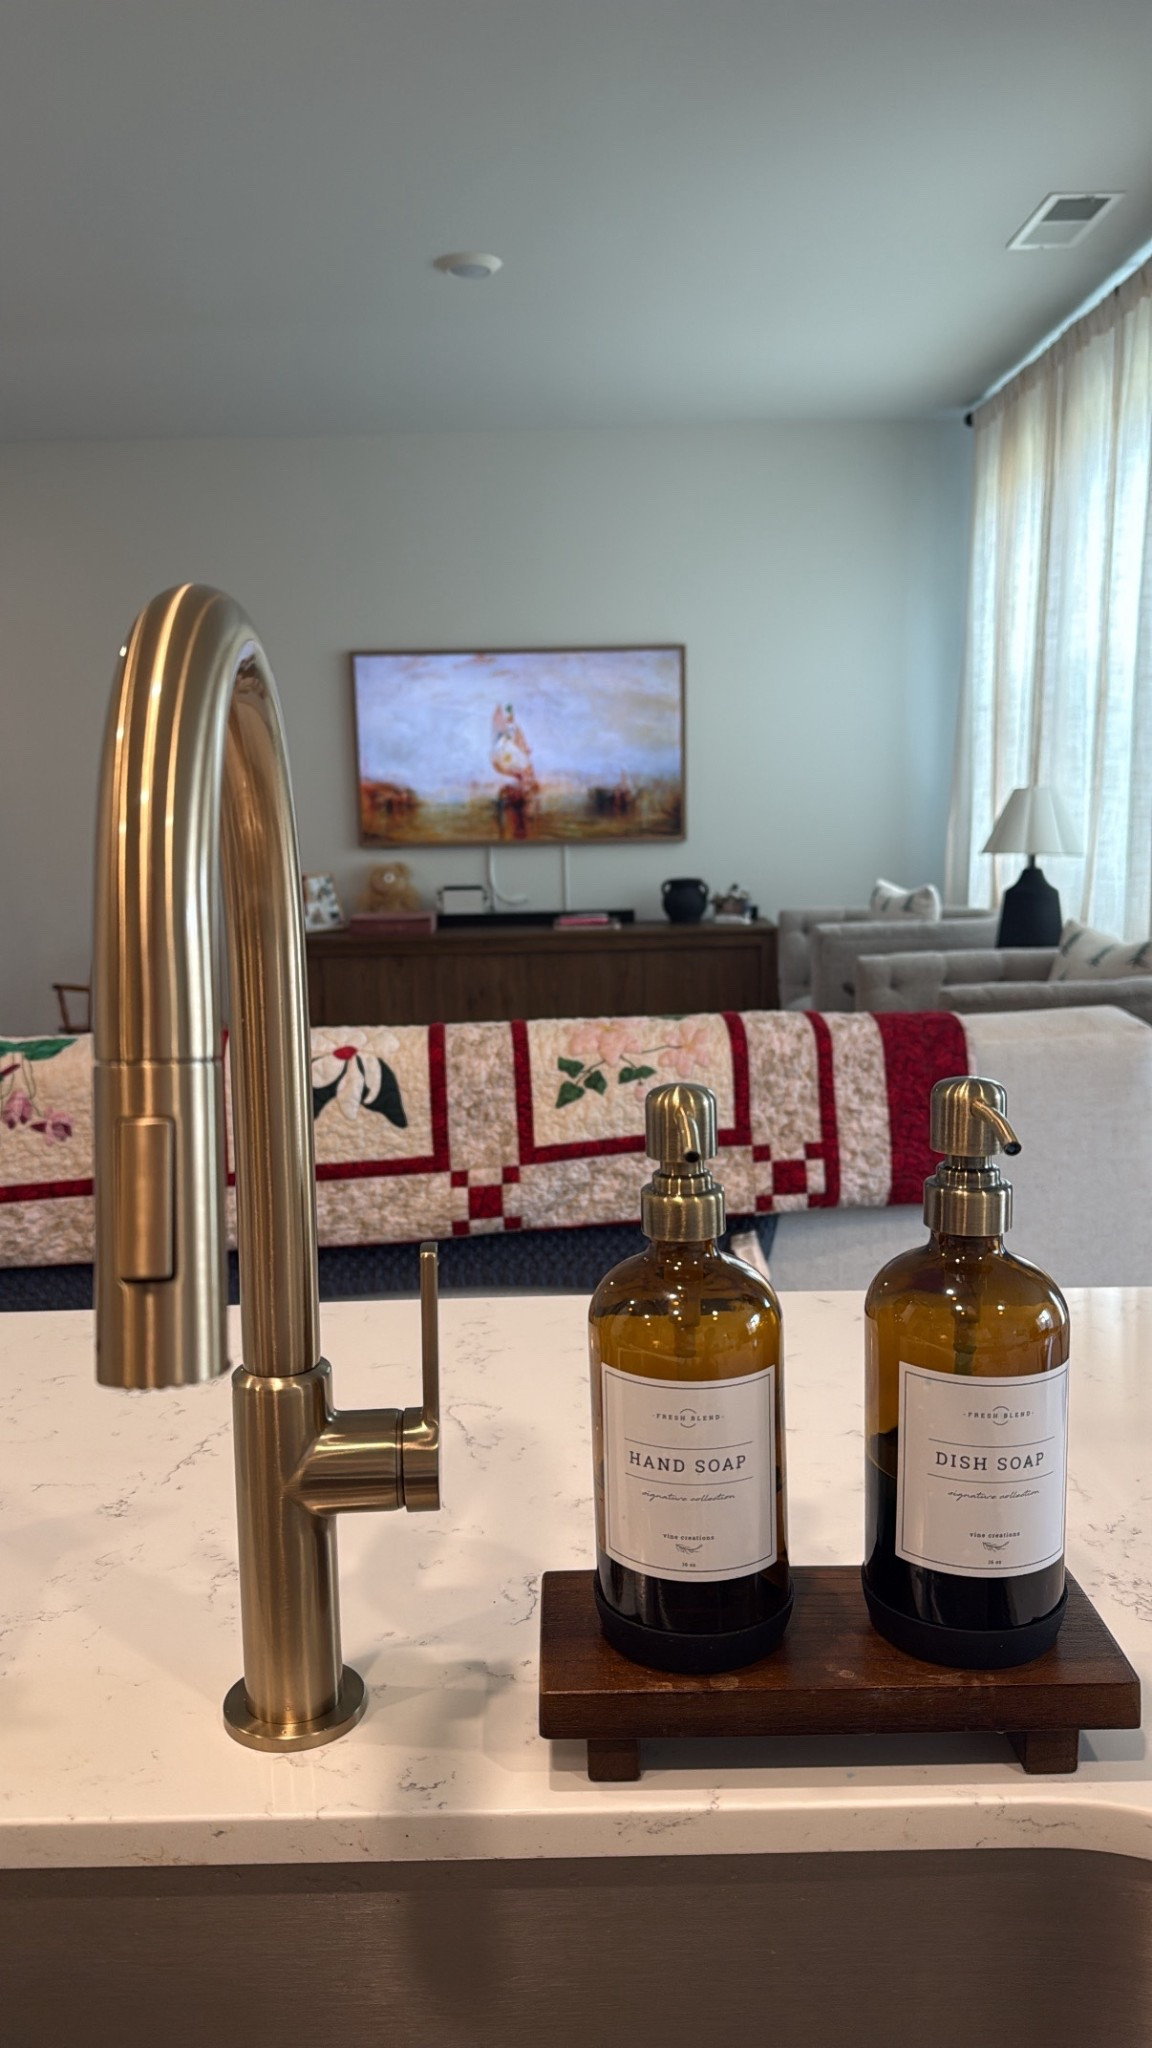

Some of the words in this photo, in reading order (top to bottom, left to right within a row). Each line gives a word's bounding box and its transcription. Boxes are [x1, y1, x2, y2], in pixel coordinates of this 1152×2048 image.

[629, 1451, 685, 1472] HAND
[695, 1455, 746, 1473] SOAP
[936, 1452, 987, 1470] DISH
[997, 1452, 1044, 1470] SOAP
[642, 1491, 687, 1502] signature
[690, 1493, 735, 1501] collection
[947, 1490, 997, 1501] signature
[1000, 1490, 1039, 1499] collection
